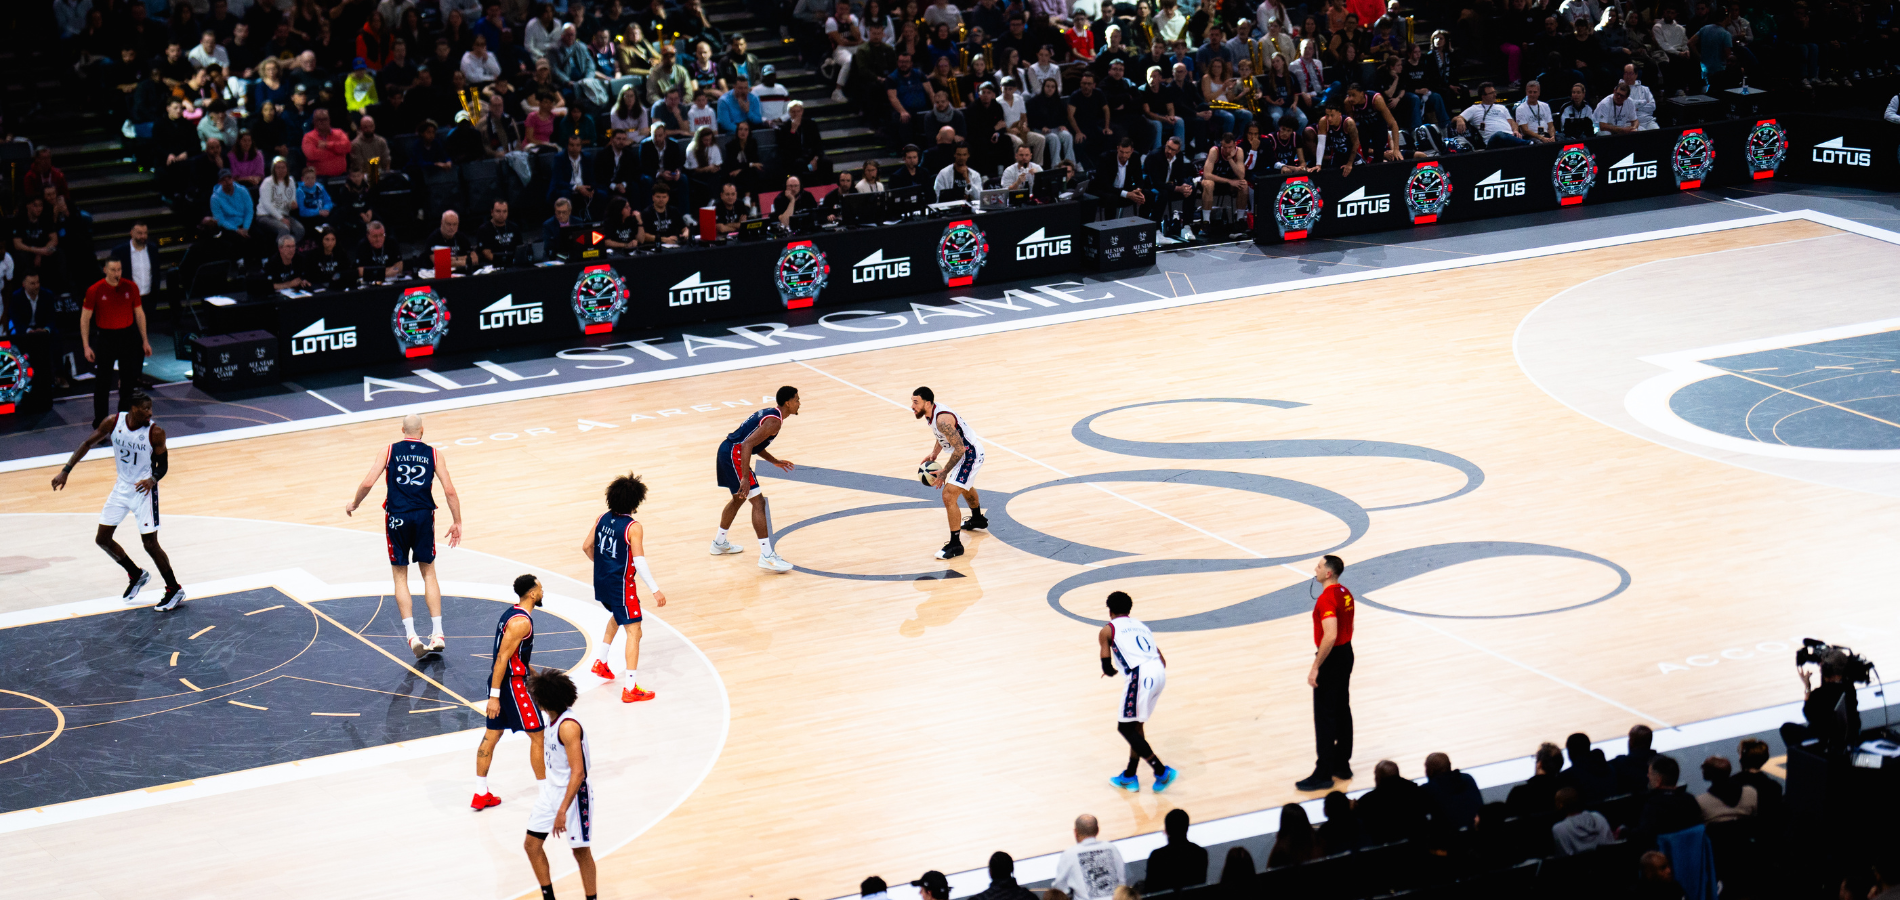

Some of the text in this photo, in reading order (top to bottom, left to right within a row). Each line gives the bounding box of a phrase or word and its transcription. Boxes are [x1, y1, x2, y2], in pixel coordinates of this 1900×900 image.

[1812, 148, 1871, 167] LOTUS
[1607, 164, 1658, 184] LOTUS
[1474, 181, 1526, 202] LOTUS
[1337, 198, 1391, 218] LOTUS
[1016, 239, 1072, 261] LOTUS
[852, 261, 911, 284] LOTUS
[669, 284, 731, 307] LOTUS
[480, 307, 544, 331] LOTUS
[292, 332, 357, 356] LOTUS
[364, 281, 1115, 402] ALL STAR GAME
[114, 437, 146, 451] ALL STAR
[120, 449, 137, 465] 21
[396, 464, 426, 486] 32
[597, 531, 618, 559] 44
